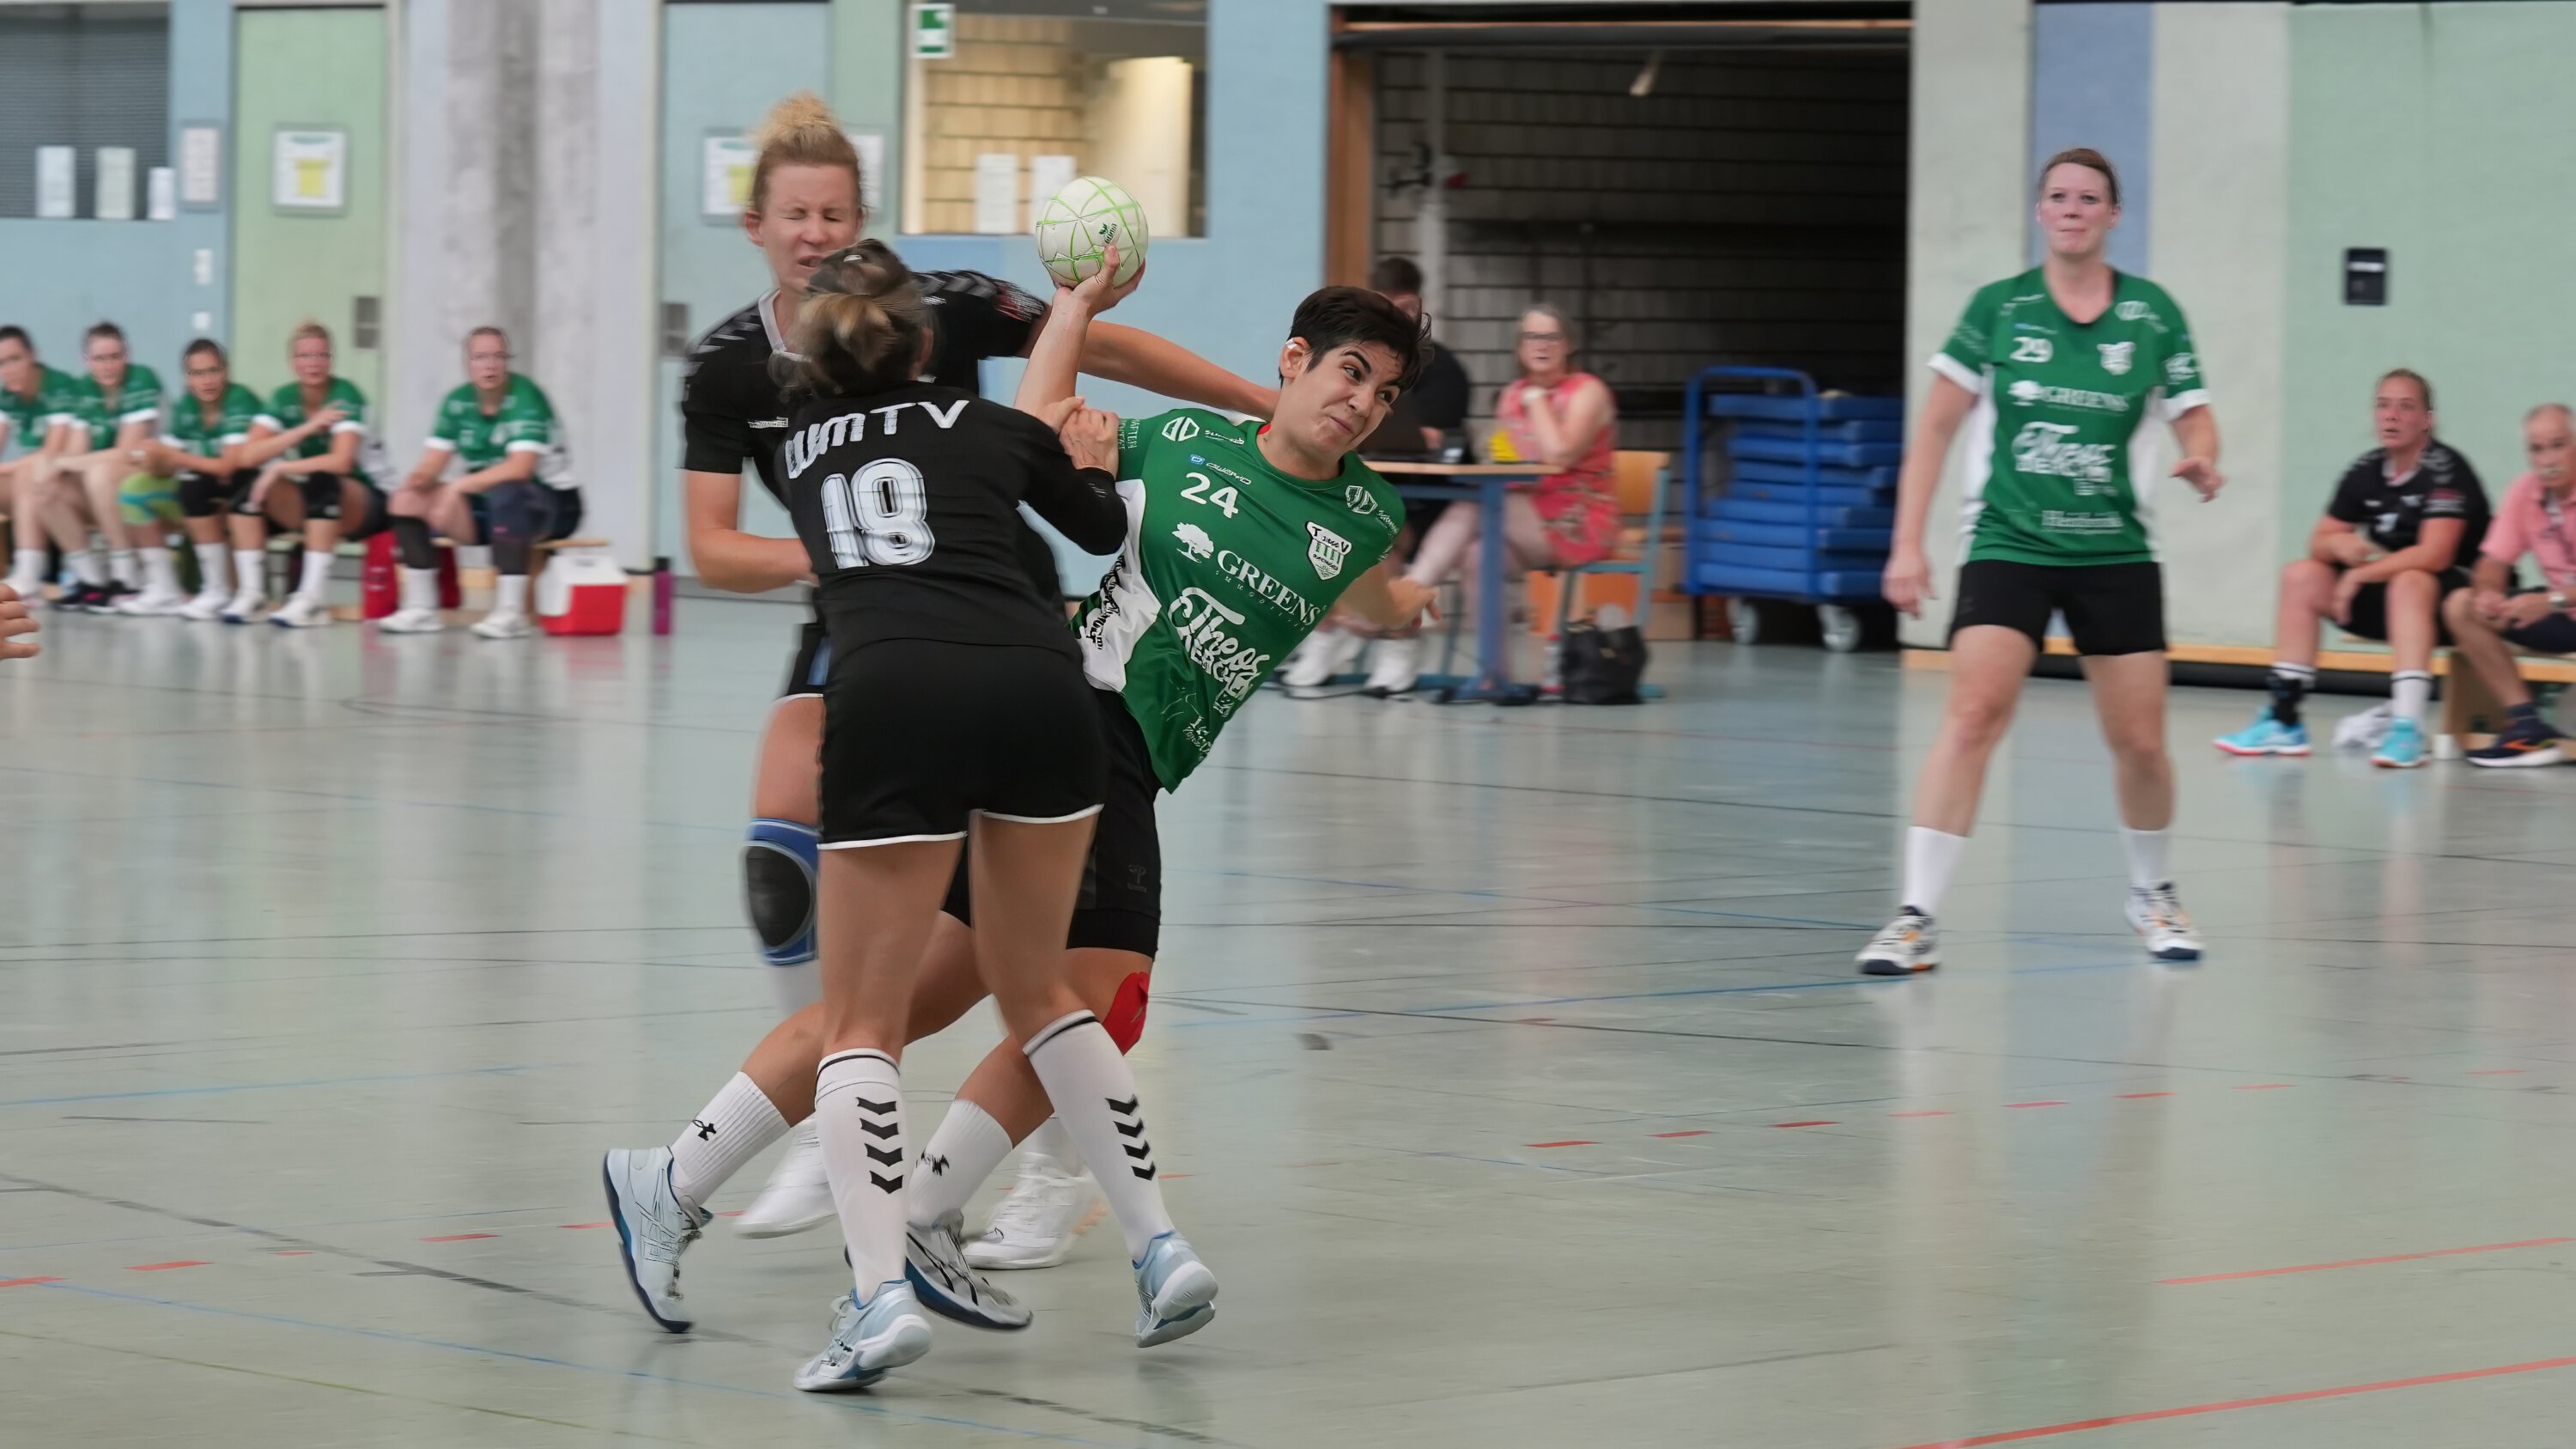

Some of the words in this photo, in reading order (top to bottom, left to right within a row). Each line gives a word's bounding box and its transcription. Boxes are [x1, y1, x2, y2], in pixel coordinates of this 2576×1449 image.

[2009, 336, 2054, 362] 29
[820, 457, 936, 569] 18
[1180, 472, 1239, 519] 24
[1217, 550, 1321, 626] GREENS
